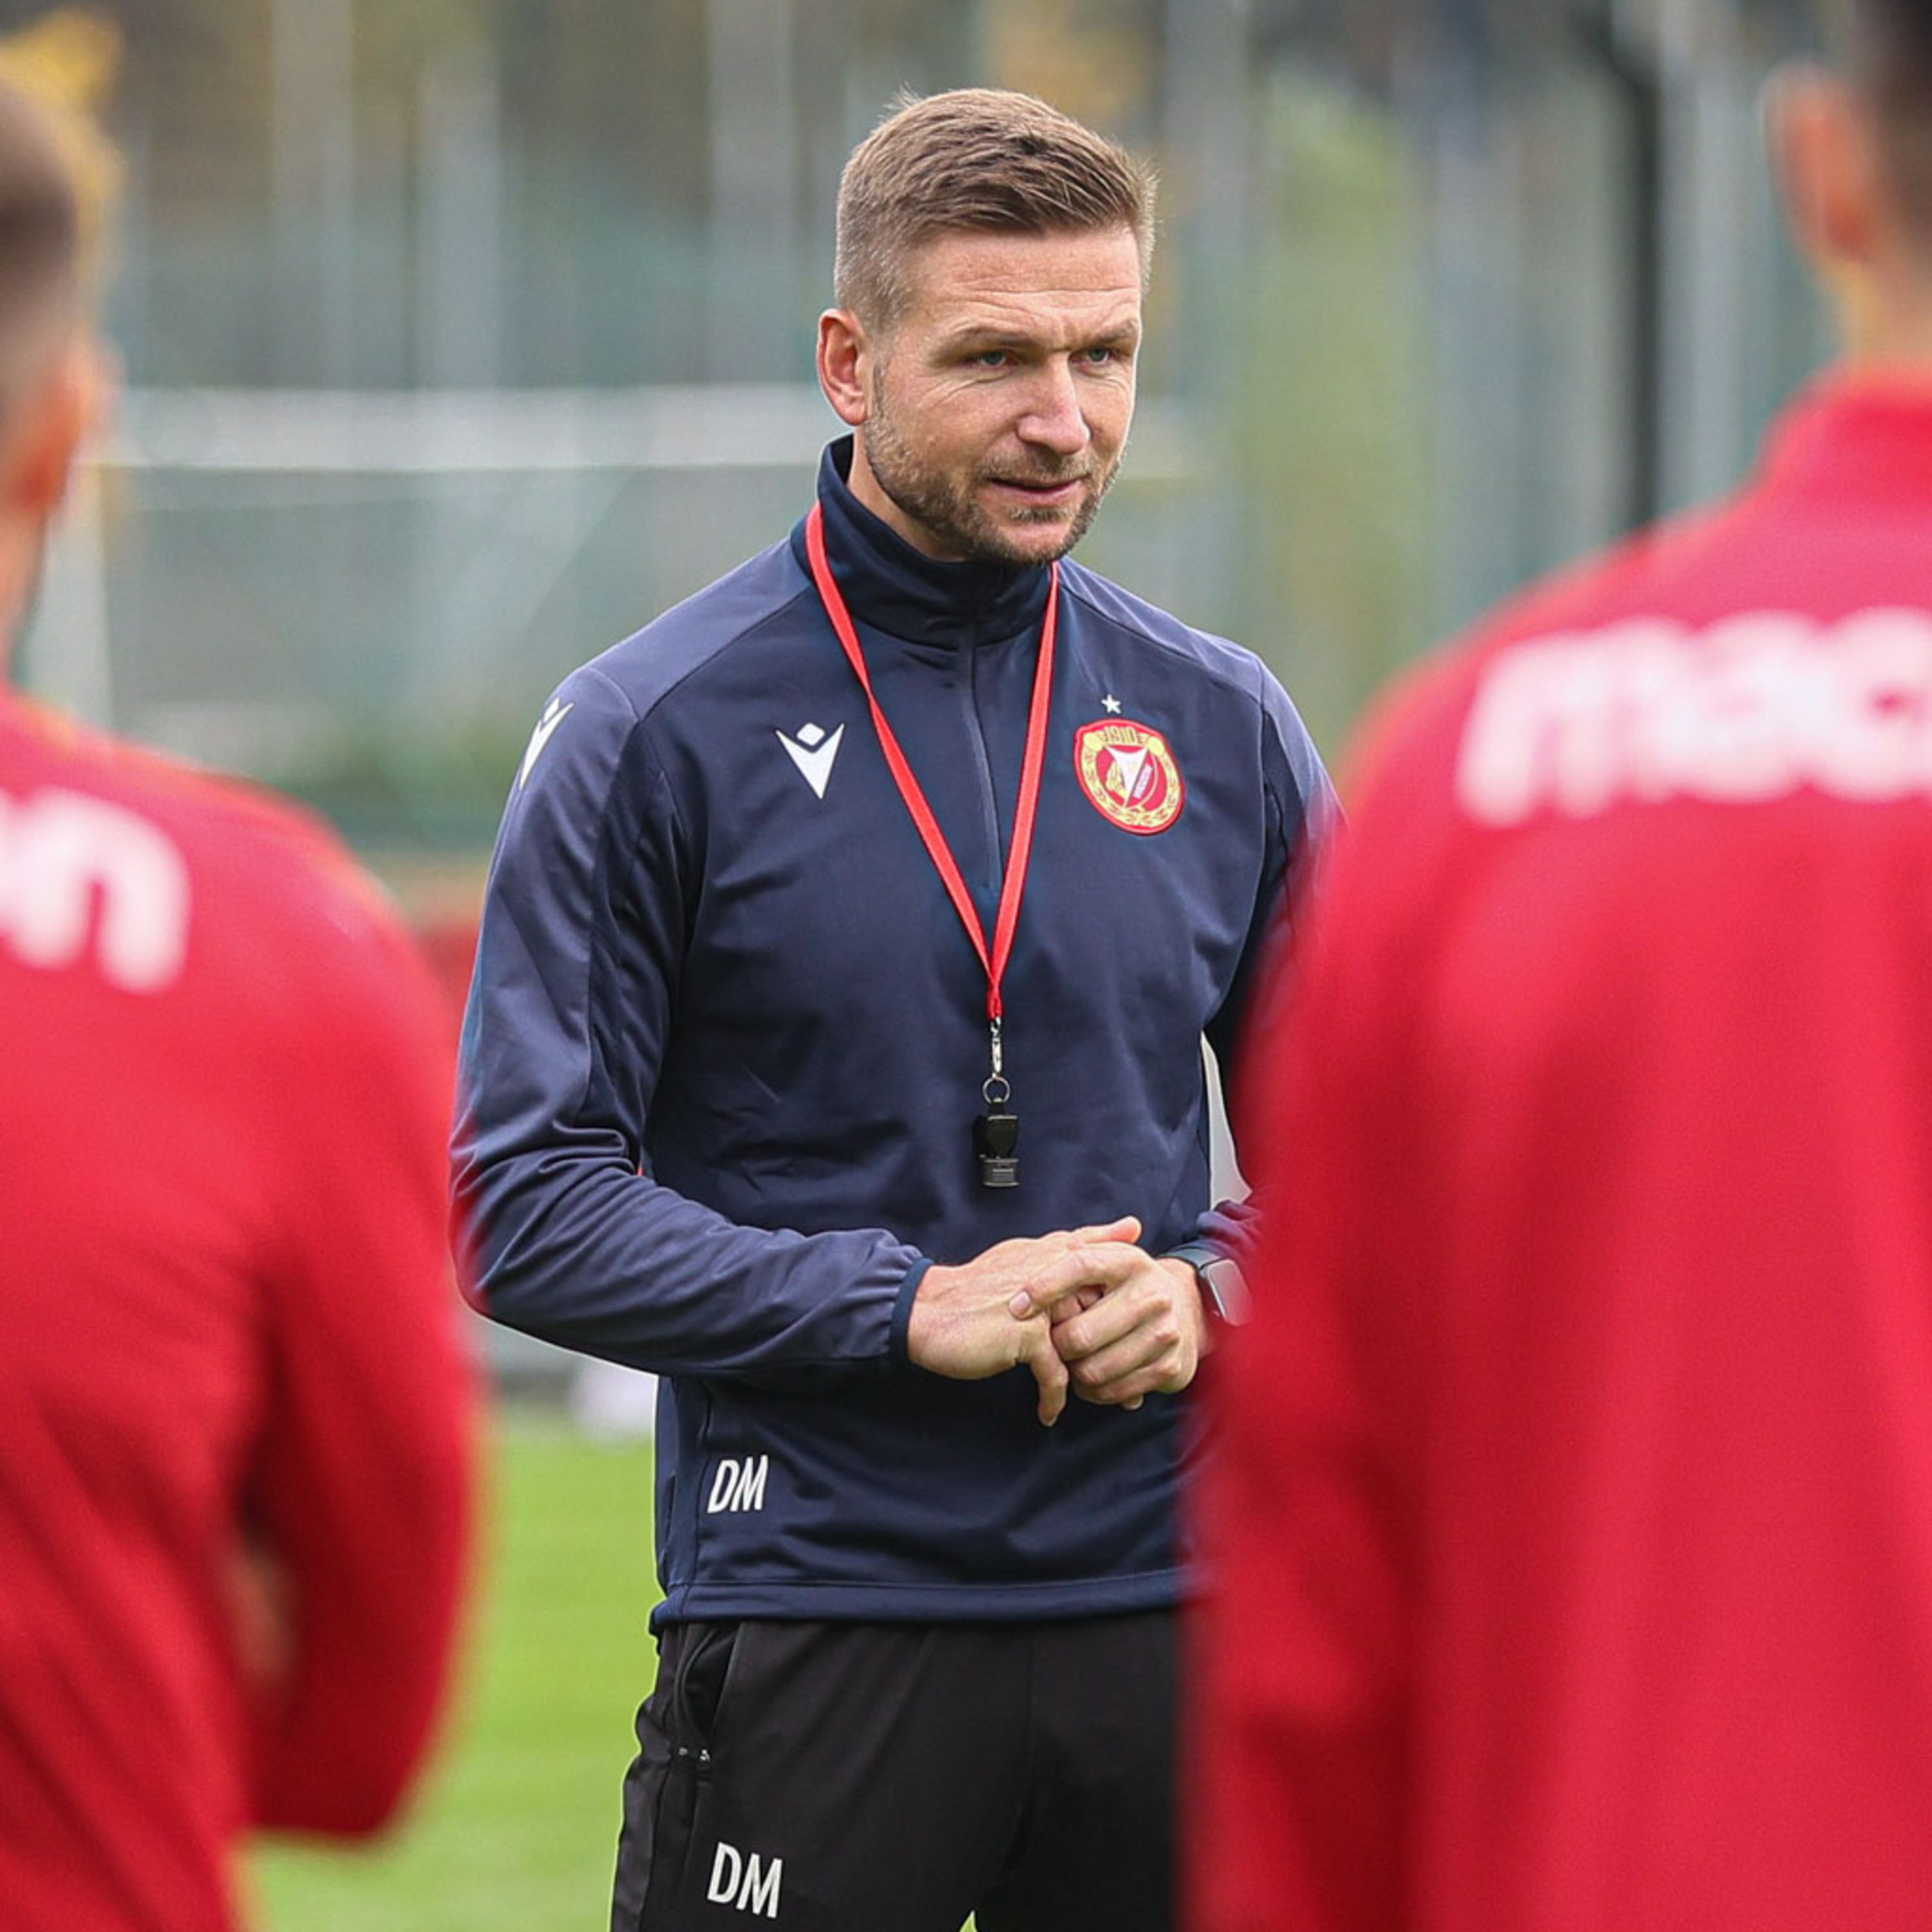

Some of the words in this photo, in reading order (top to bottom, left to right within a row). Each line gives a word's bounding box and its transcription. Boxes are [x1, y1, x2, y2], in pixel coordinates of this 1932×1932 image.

[0, 790, 190, 990] n
[707, 1454, 768, 1513] DM
[707, 1842, 782, 1918] DM
